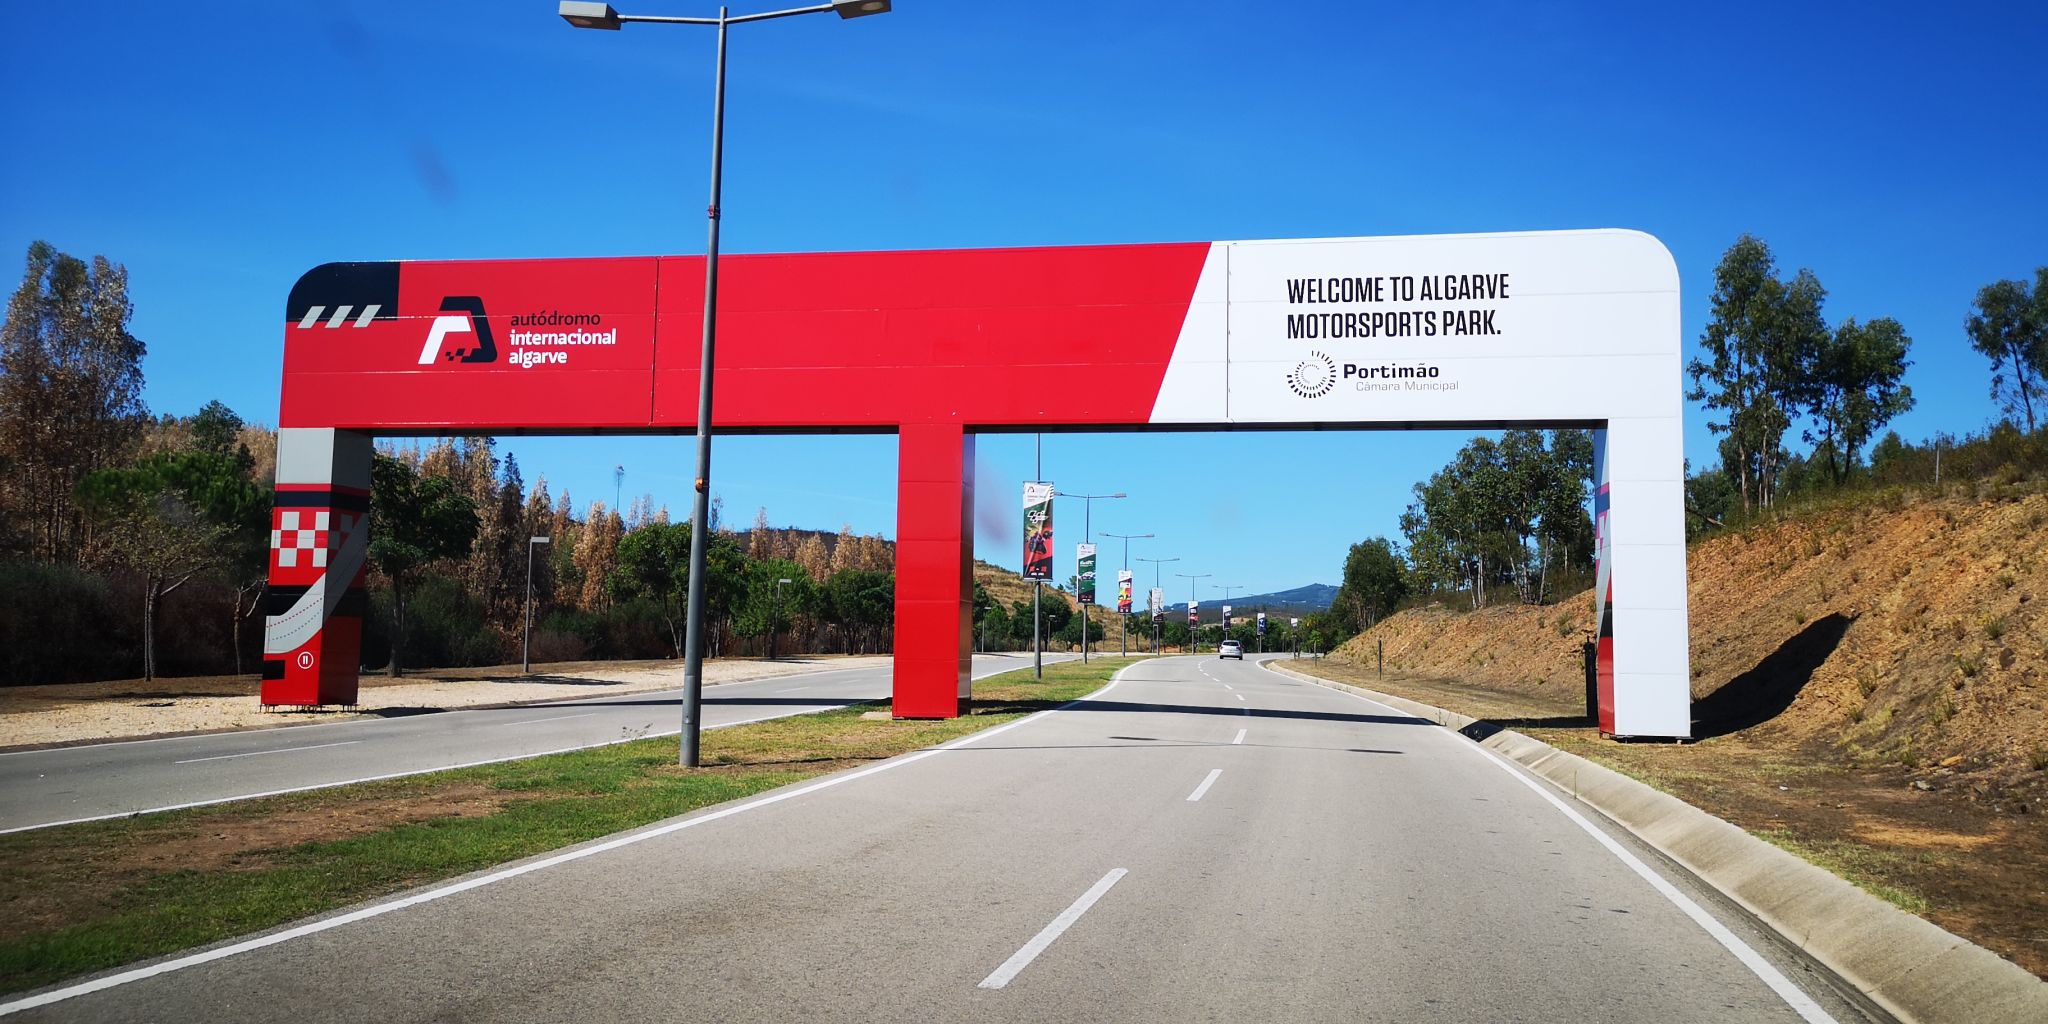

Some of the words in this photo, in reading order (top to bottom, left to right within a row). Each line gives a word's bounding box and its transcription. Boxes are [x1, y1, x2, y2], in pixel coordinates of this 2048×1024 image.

[1287, 276, 1384, 304] WELCOME
[1389, 276, 1414, 302] TO
[1420, 273, 1510, 301] ALGARVE
[511, 310, 601, 326] autódromo
[1287, 311, 1437, 339] MOTORSPORTS
[1442, 309, 1502, 336] PARK.
[509, 328, 617, 346] internacional
[509, 347, 568, 368] algarve
[1343, 362, 1440, 379] Portimão
[1355, 380, 1400, 392] Câmara
[1404, 380, 1459, 392] Municipal
